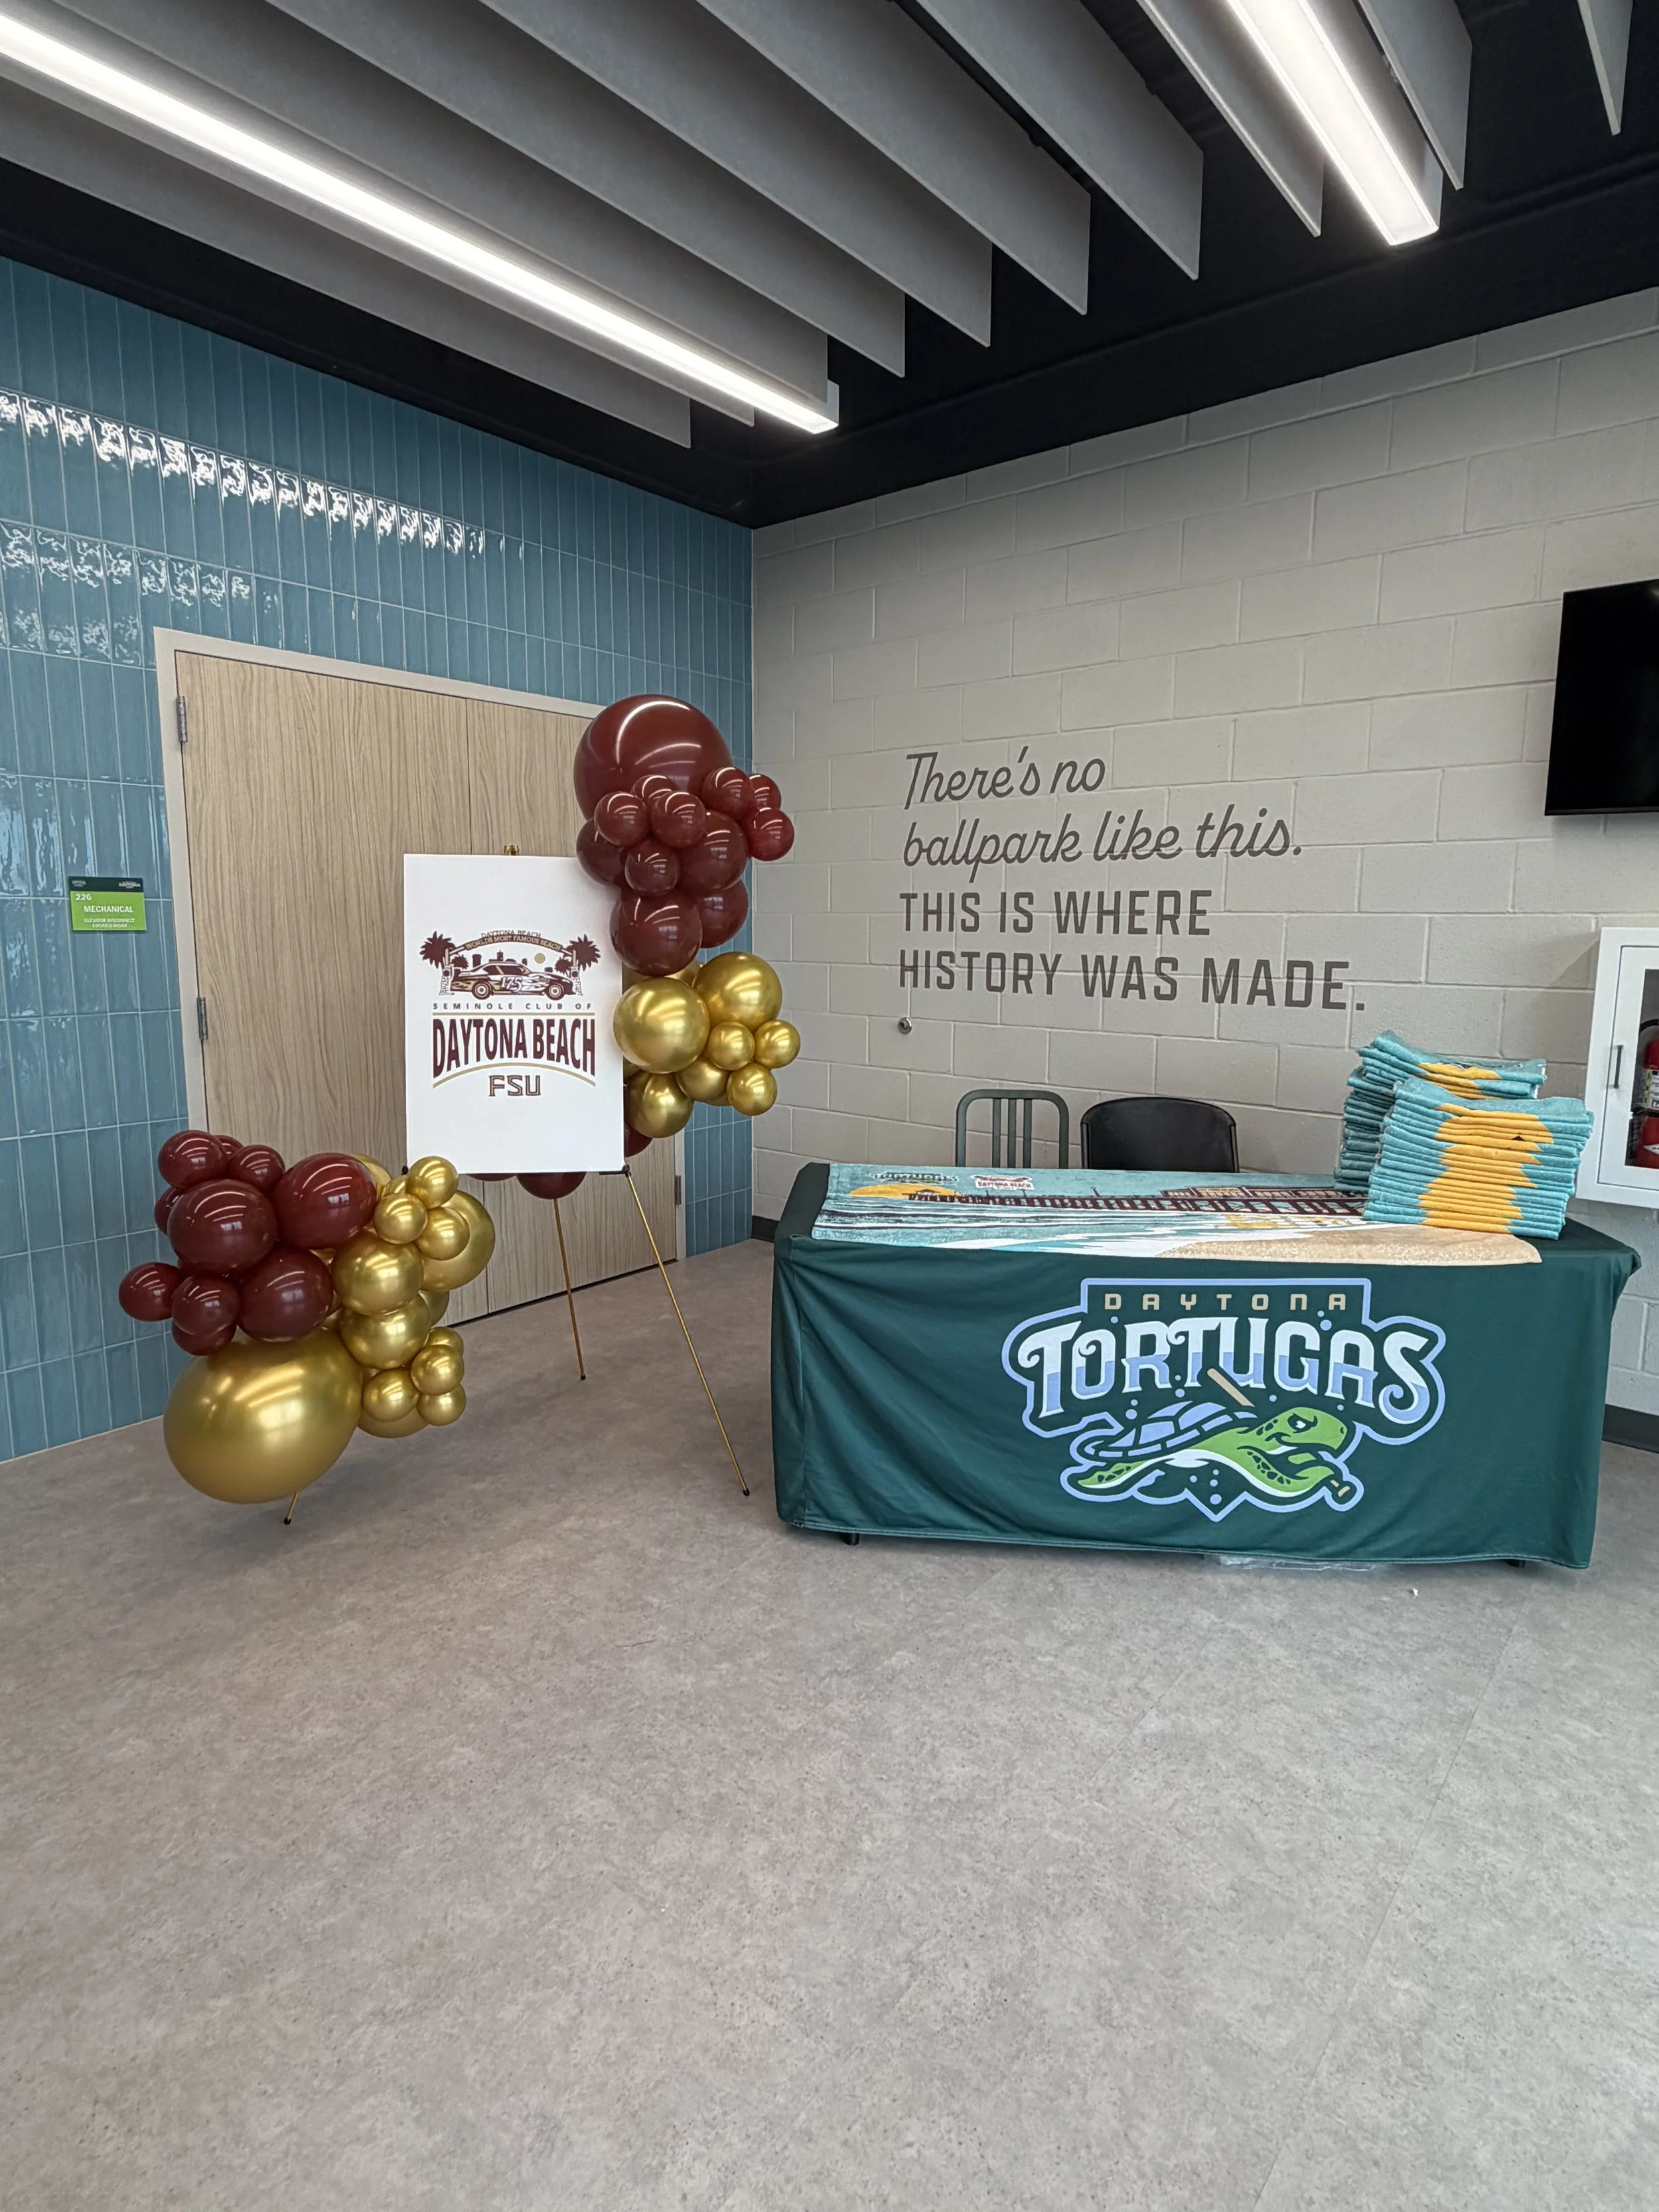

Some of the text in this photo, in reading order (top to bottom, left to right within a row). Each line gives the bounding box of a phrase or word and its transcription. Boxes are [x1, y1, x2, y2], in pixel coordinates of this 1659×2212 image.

[904, 746, 1106, 809] There's no
[903, 804, 1303, 883] ballpark like this.
[480, 929, 515, 938] DAYTONA
[900, 890, 1212, 936] THIS IS WHERE
[540, 940, 561, 951] BEACH
[501, 976, 523, 992] 175
[899, 950, 1365, 1011] HISTORY WAS MADE.
[433, 1019, 595, 1078] DAYTONA BEACH
[488, 1075, 541, 1096] FSU
[1104, 1293, 1346, 1311] DAYTONA
[1017, 1317, 1430, 1425] TORTUGAS
